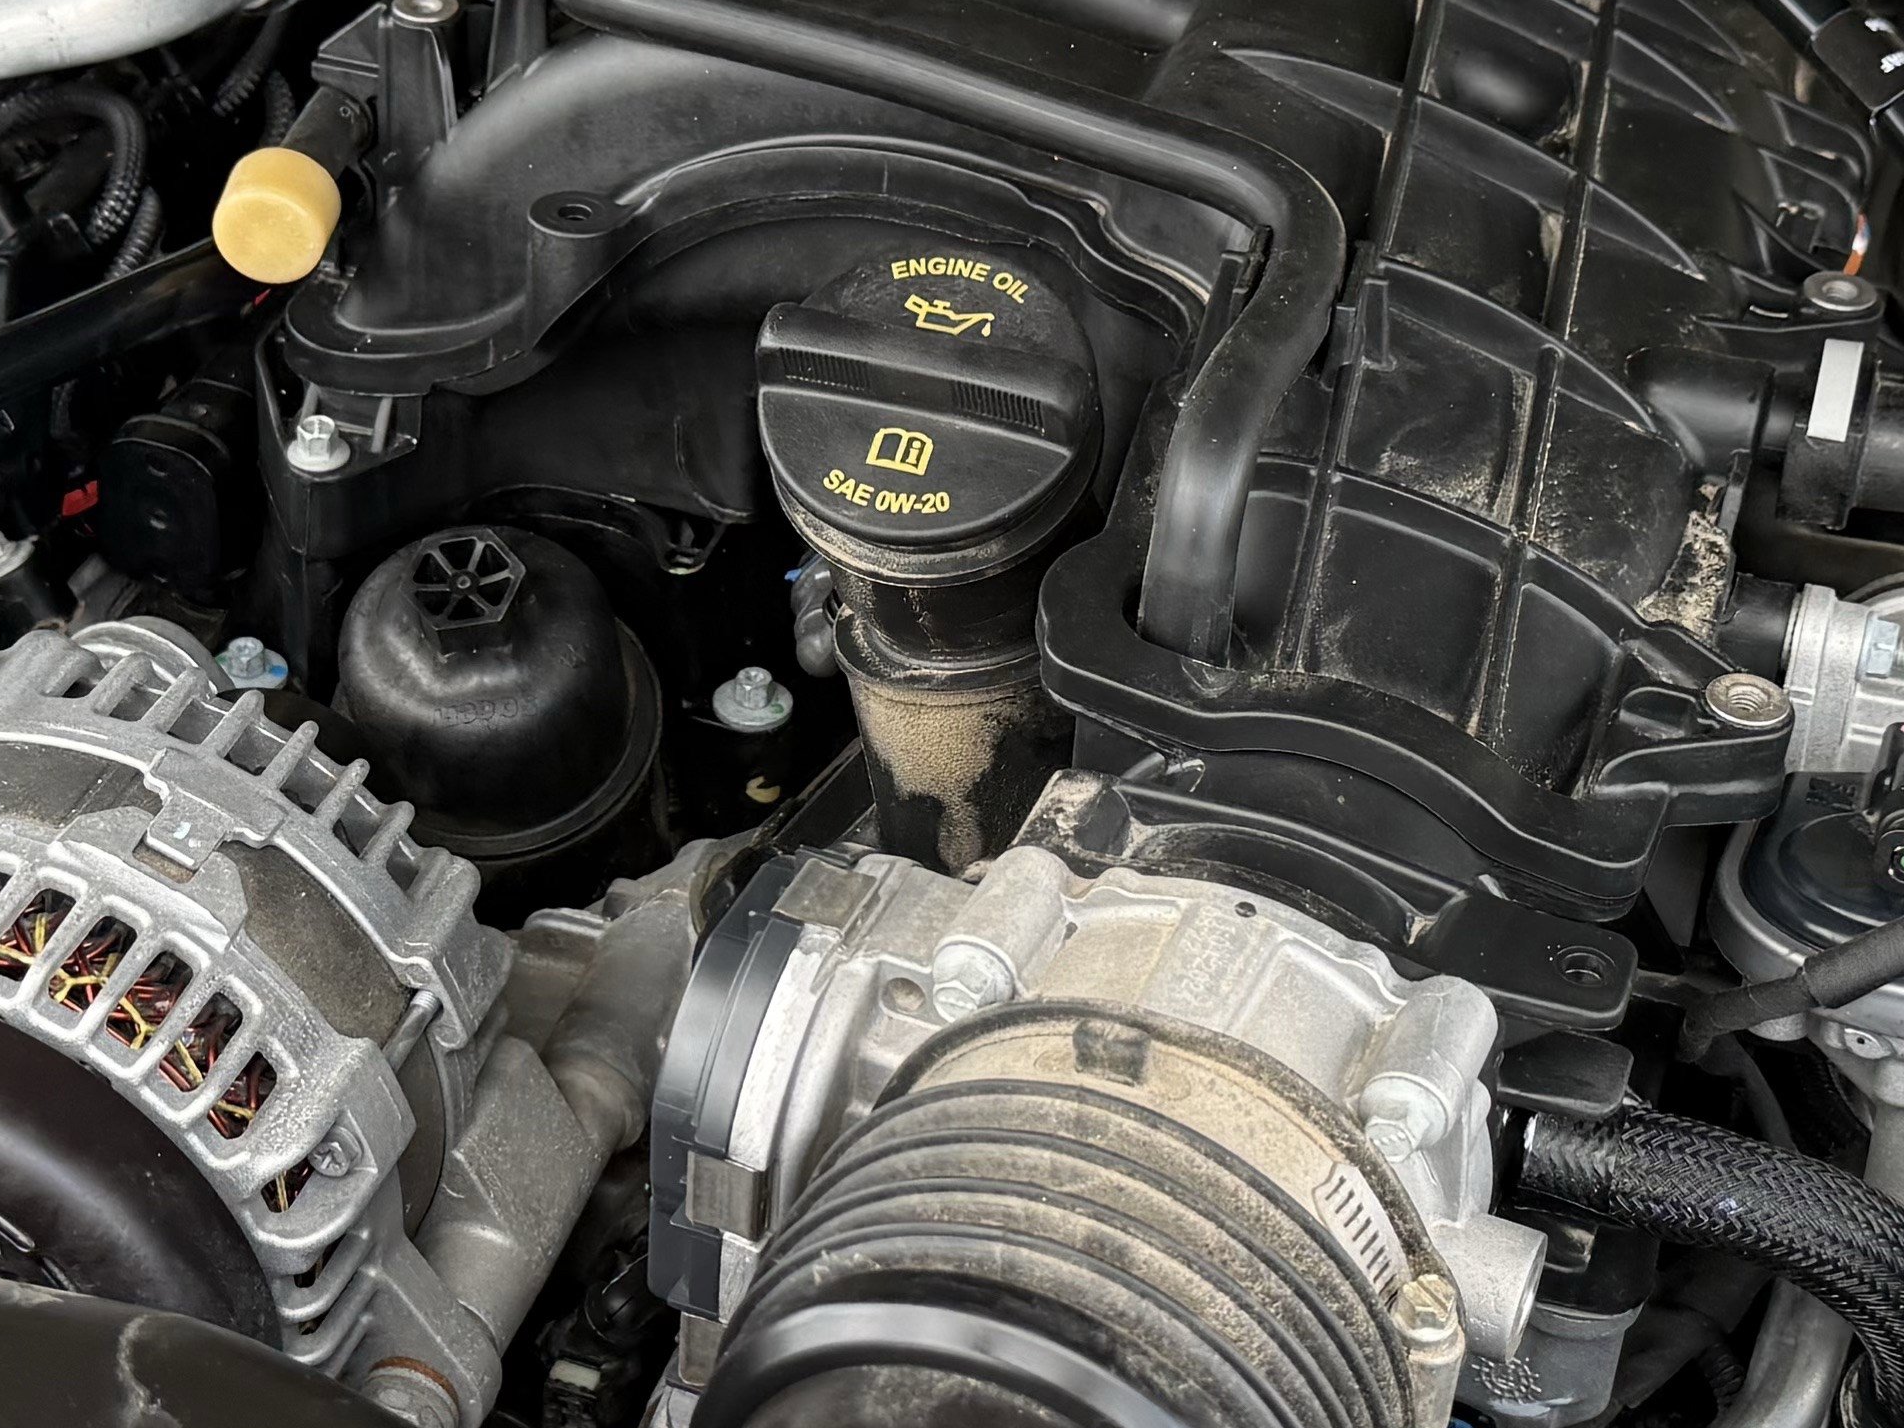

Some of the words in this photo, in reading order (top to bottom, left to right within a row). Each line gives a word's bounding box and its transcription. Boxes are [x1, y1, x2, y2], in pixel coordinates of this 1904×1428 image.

[891, 257, 991, 282] ENGINE
[992, 272, 1029, 304] OIL
[823, 469, 875, 506] SAE
[875, 491, 950, 514] 0W-20
